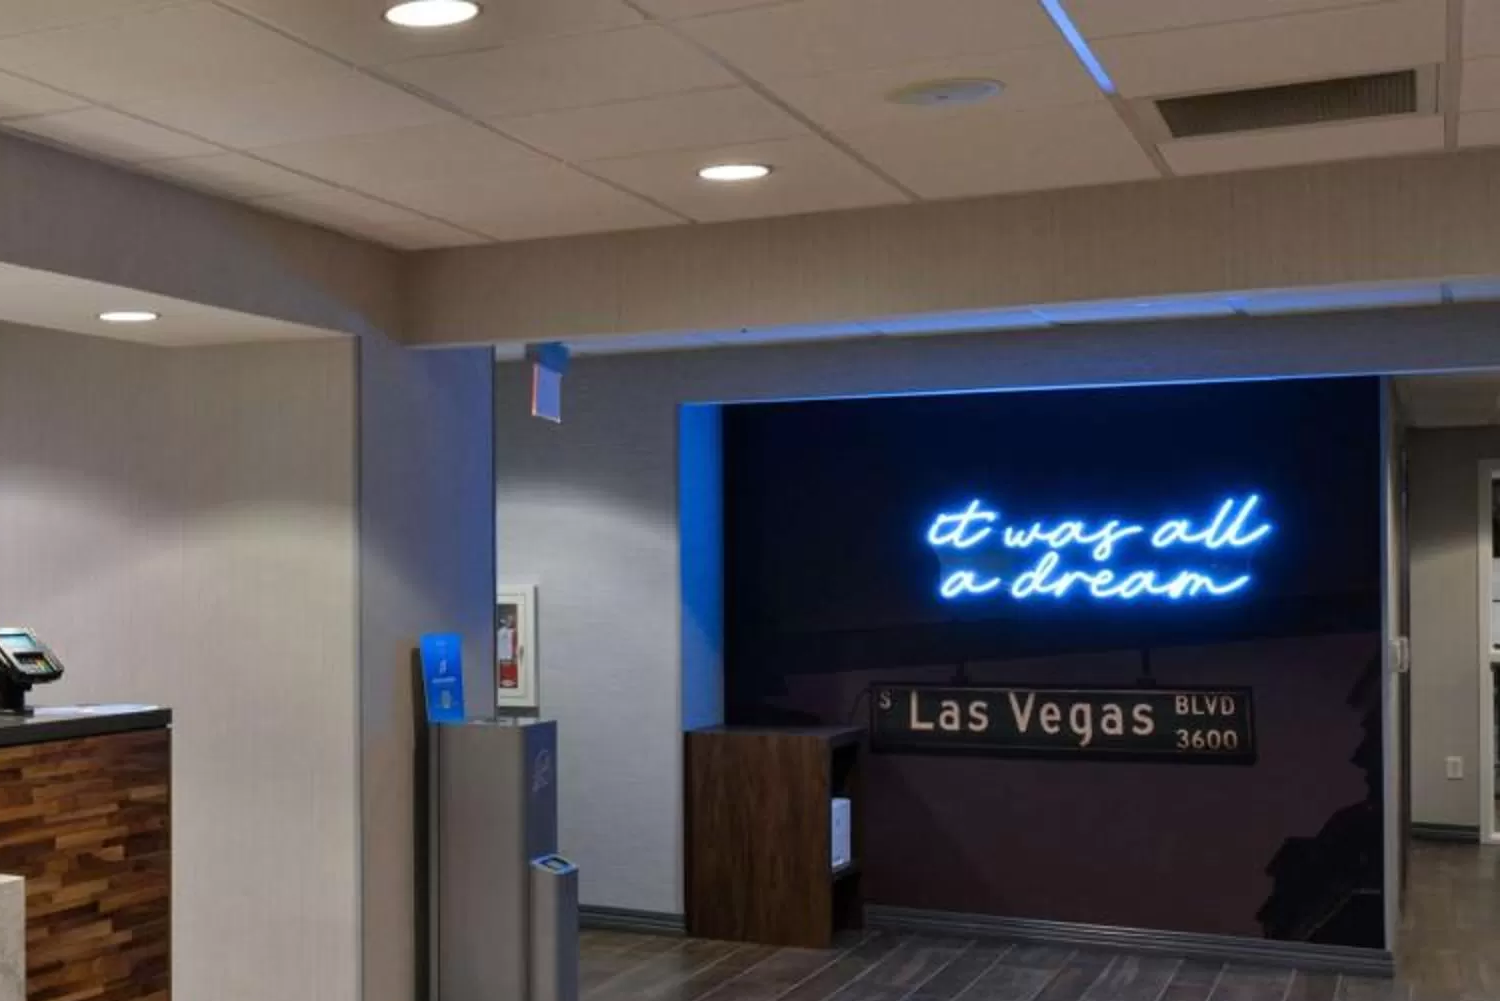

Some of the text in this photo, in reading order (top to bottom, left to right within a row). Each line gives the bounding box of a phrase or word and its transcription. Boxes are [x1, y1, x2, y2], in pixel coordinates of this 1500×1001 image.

[927, 494, 1272, 562] it was all
[940, 550, 1250, 600] a dream
[879, 688, 1236, 748] S Las Vegas BLVD
[1175, 728, 1239, 750] 3600
